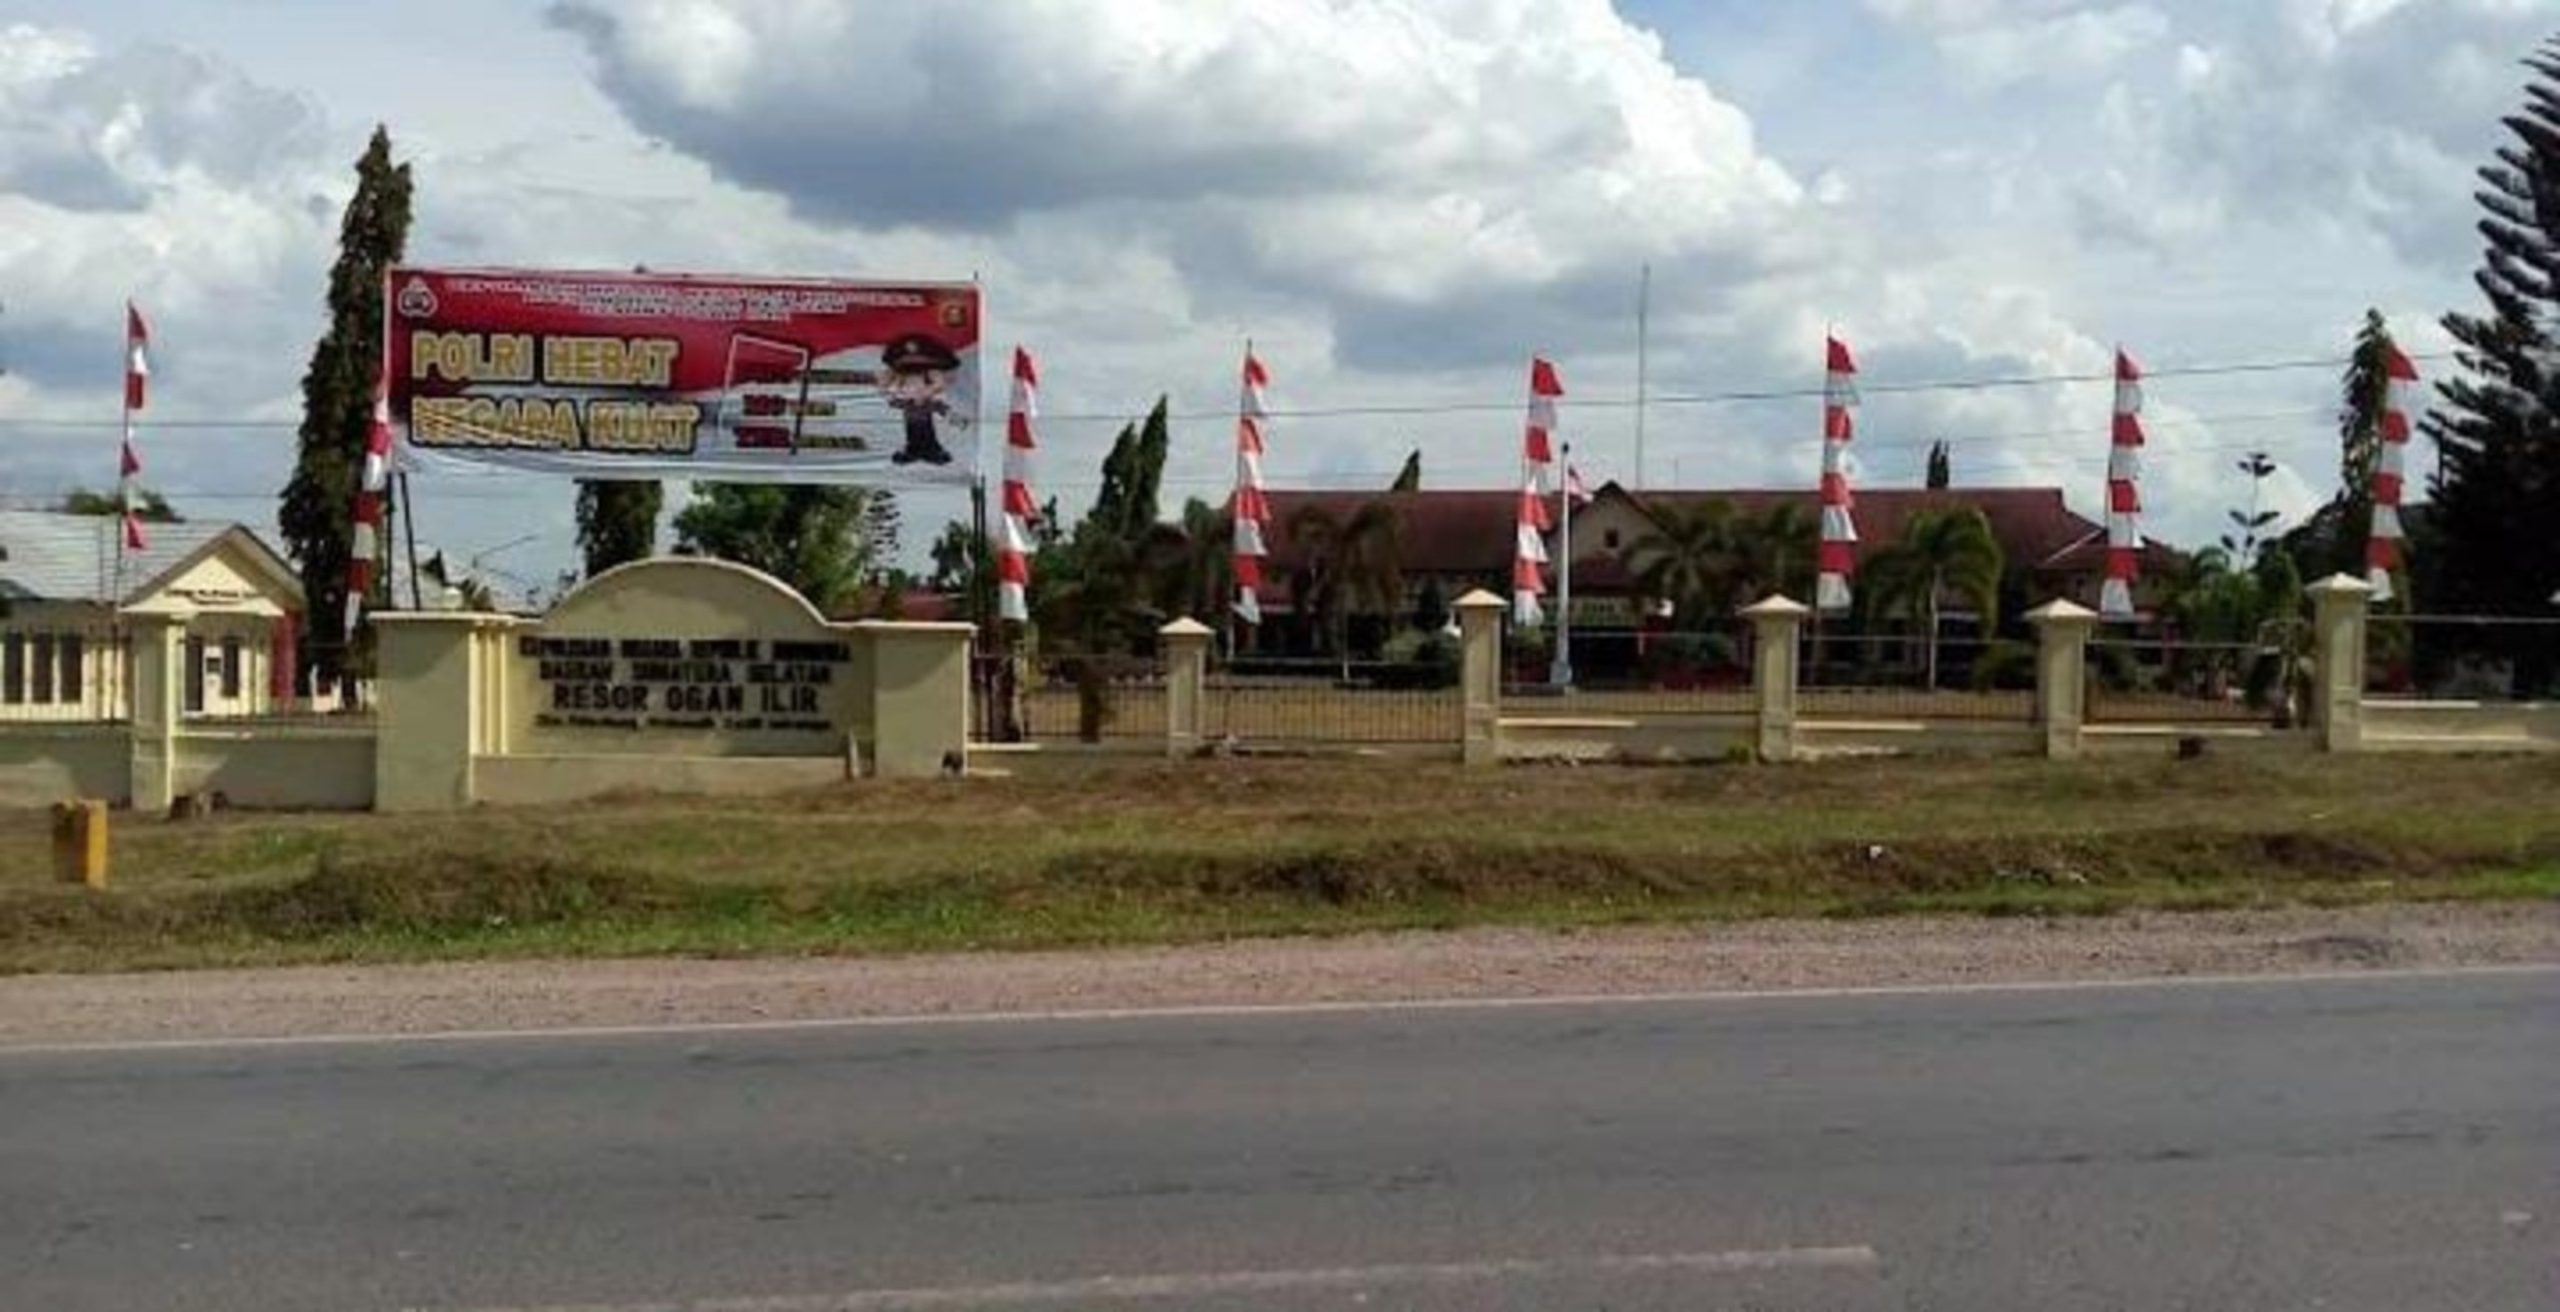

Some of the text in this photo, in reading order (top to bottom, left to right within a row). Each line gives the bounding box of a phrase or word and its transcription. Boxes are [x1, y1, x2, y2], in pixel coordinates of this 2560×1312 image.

[411, 332, 679, 385] POLRI HEBAT
[411, 395, 580, 448] NEGARA
[588, 401, 699, 450] KUAT
[554, 683, 818, 712] RESOR OGAN ILIR
